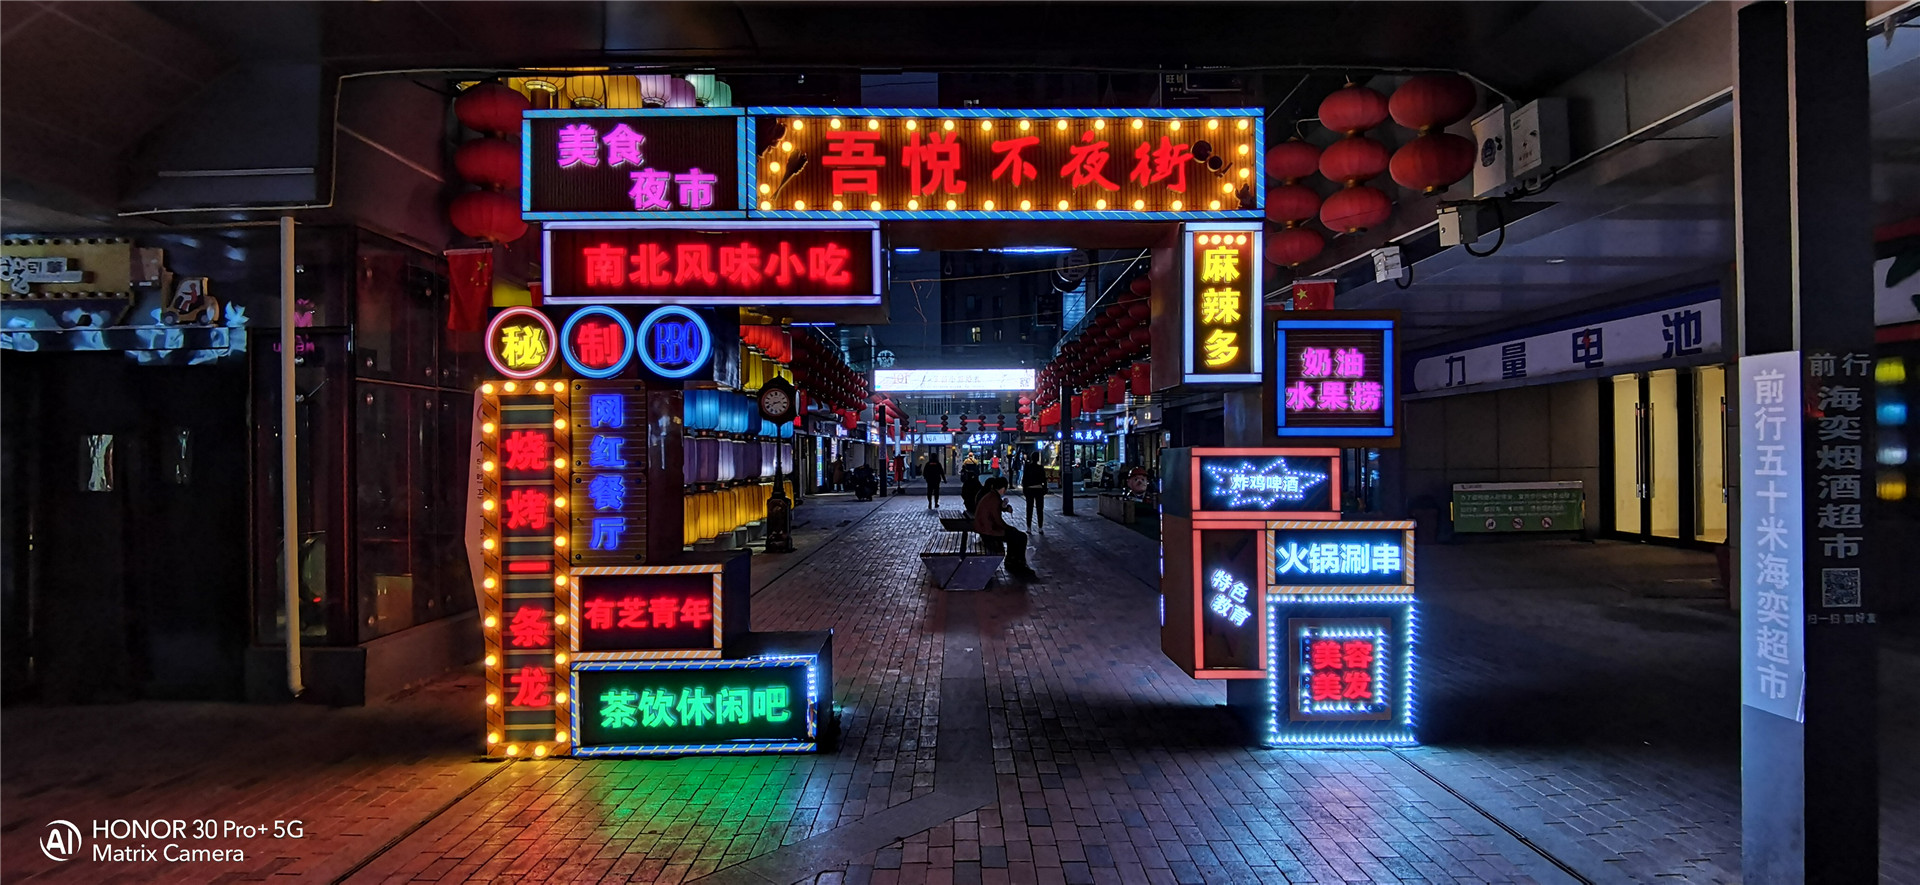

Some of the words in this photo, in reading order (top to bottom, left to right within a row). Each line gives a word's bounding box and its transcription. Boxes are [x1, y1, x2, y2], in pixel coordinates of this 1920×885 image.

[557, 122, 646, 168] 美食
[821, 129, 1196, 198] 吾悦不夜街
[627, 167, 718, 212] 夜市
[582, 240, 853, 288] 南北风味小吃
[1201, 245, 1241, 368] 麻辣多
[653, 321, 700, 365] BBQ
[1301, 346, 1366, 379] 奶油
[1445, 310, 1702, 388] 力量电池
[1808, 352, 1873, 379] 前行
[1285, 381, 1384, 412] 水果捞
[588, 393, 625, 550] 网红餐厅
[1230, 474, 1300, 493] 炸鸡啤酒
[1816, 384, 1864, 560] 海奕烟酒超市
[1752, 368, 1790, 701] 前行五十米海奕超市
[505, 430, 552, 708] 烧烤一条龙
[1276, 542, 1402, 575] 火锅涮串
[1209, 567, 1250, 604] 特色
[583, 597, 713, 630] 有芝青年
[1209, 593, 1252, 628] 教育
[1311, 640, 1374, 670] 美容
[599, 685, 792, 729] 茶饮休闲吧
[1311, 670, 1373, 701] 美发
